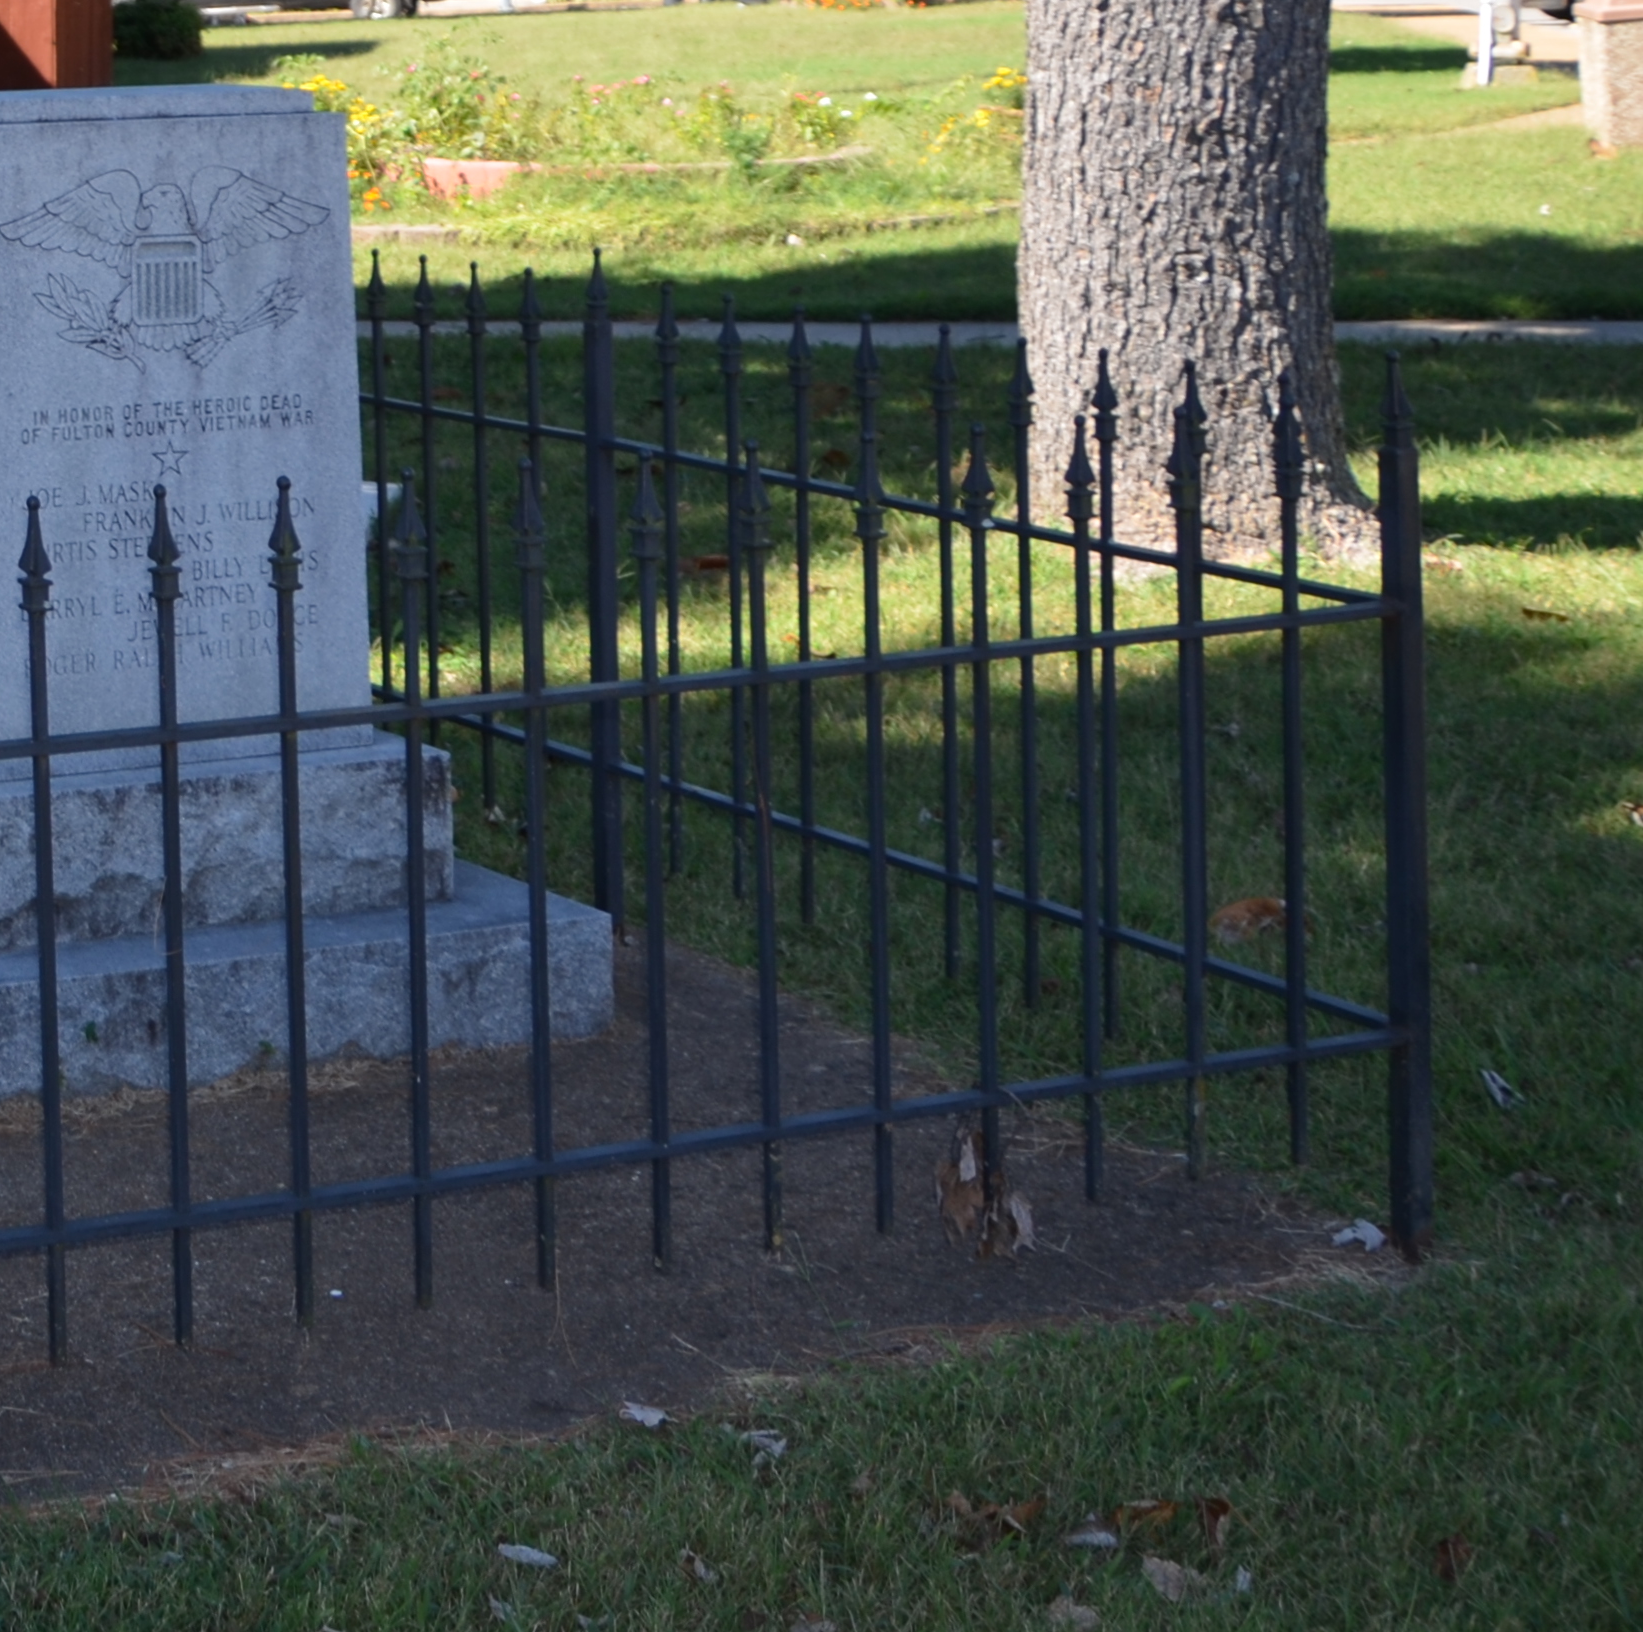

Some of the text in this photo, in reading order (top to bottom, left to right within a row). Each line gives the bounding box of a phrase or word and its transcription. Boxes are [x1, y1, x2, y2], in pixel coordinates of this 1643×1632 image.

[32, 394, 302, 426] IN HONOR OF THE HEROIC DEAD
[21, 411, 314, 445] OF FULTON COUNTY VIETNAM WAR
[75, 486, 91, 506] J.
[84, 497, 316, 533] FRANKN J. WILLION
[109, 533, 214, 560] STEENS
[193, 558, 244, 581] BILLY
[114, 590, 130, 614] E.
[138, 584, 257, 613] MARTNEY
[128, 617, 207, 642] JEELL
[248, 605, 318, 631] DOGE
[114, 644, 185, 671] RALH
[199, 632, 304, 662] WILLIAS
